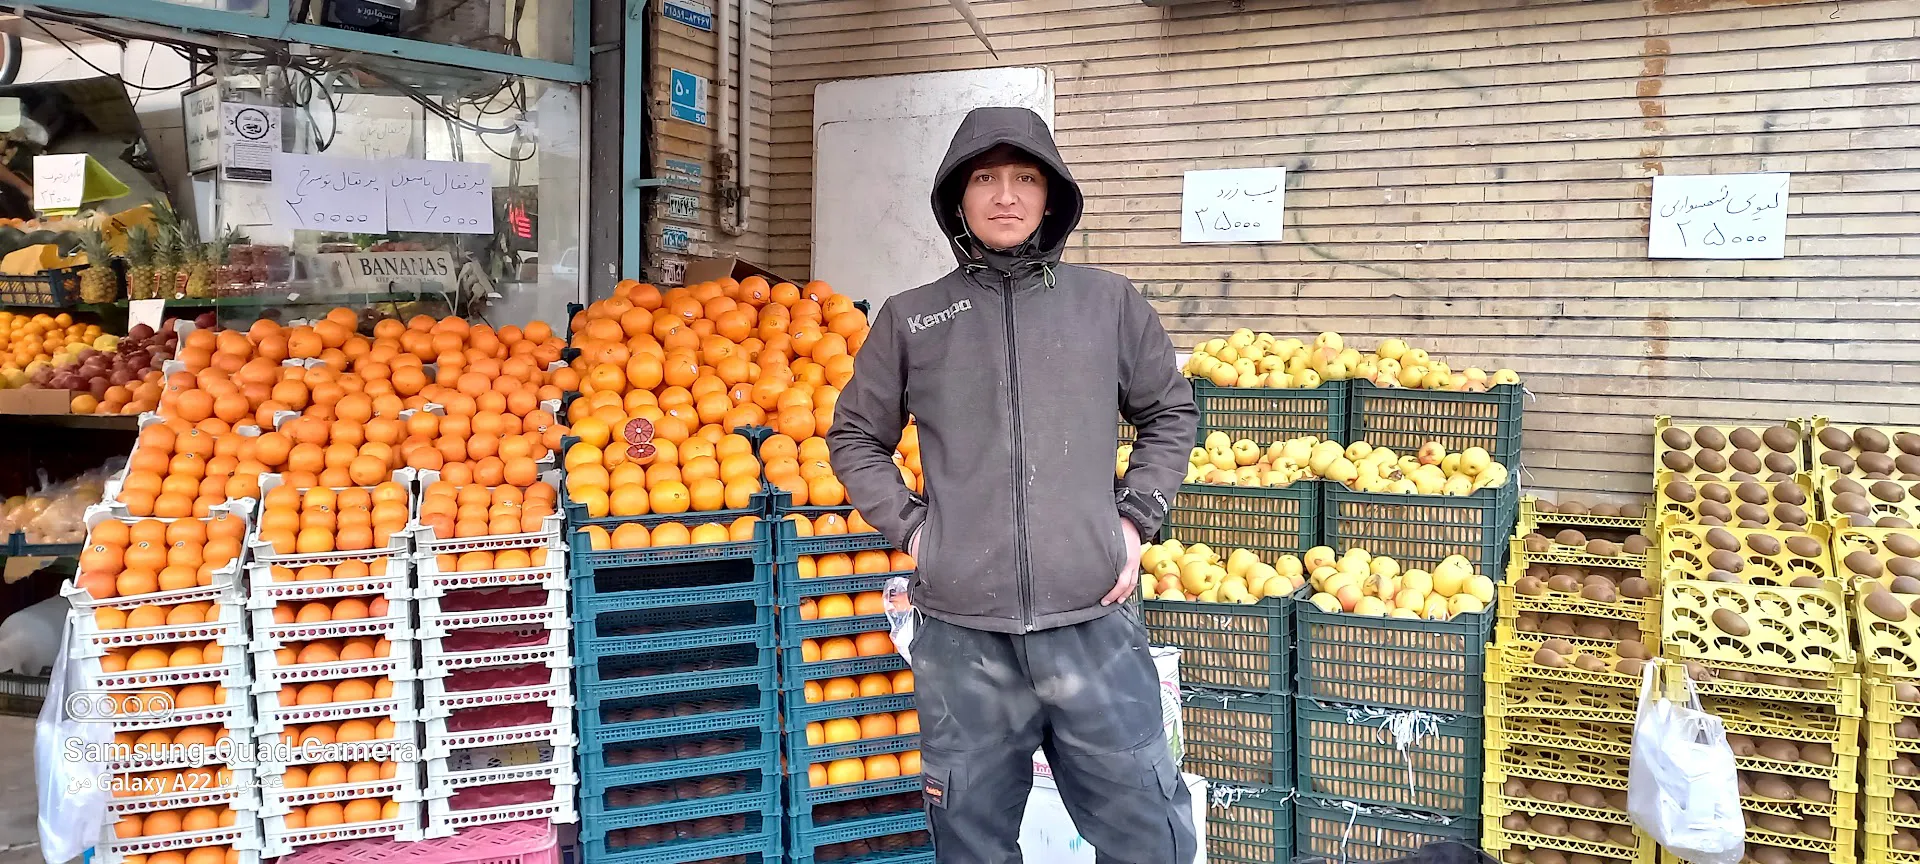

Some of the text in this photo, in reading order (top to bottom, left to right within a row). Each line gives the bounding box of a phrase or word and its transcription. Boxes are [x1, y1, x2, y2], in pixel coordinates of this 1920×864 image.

[675, 79, 690, 96] ۵۰
[695, 113, 706, 123] 50
[331, 170, 379, 192] پرتقال
[432, 172, 485, 196] پرتقال
[1216, 182, 1239, 201] زرد
[360, 257, 448, 276] BANANAS
[906, 298, 973, 334] Kempa
